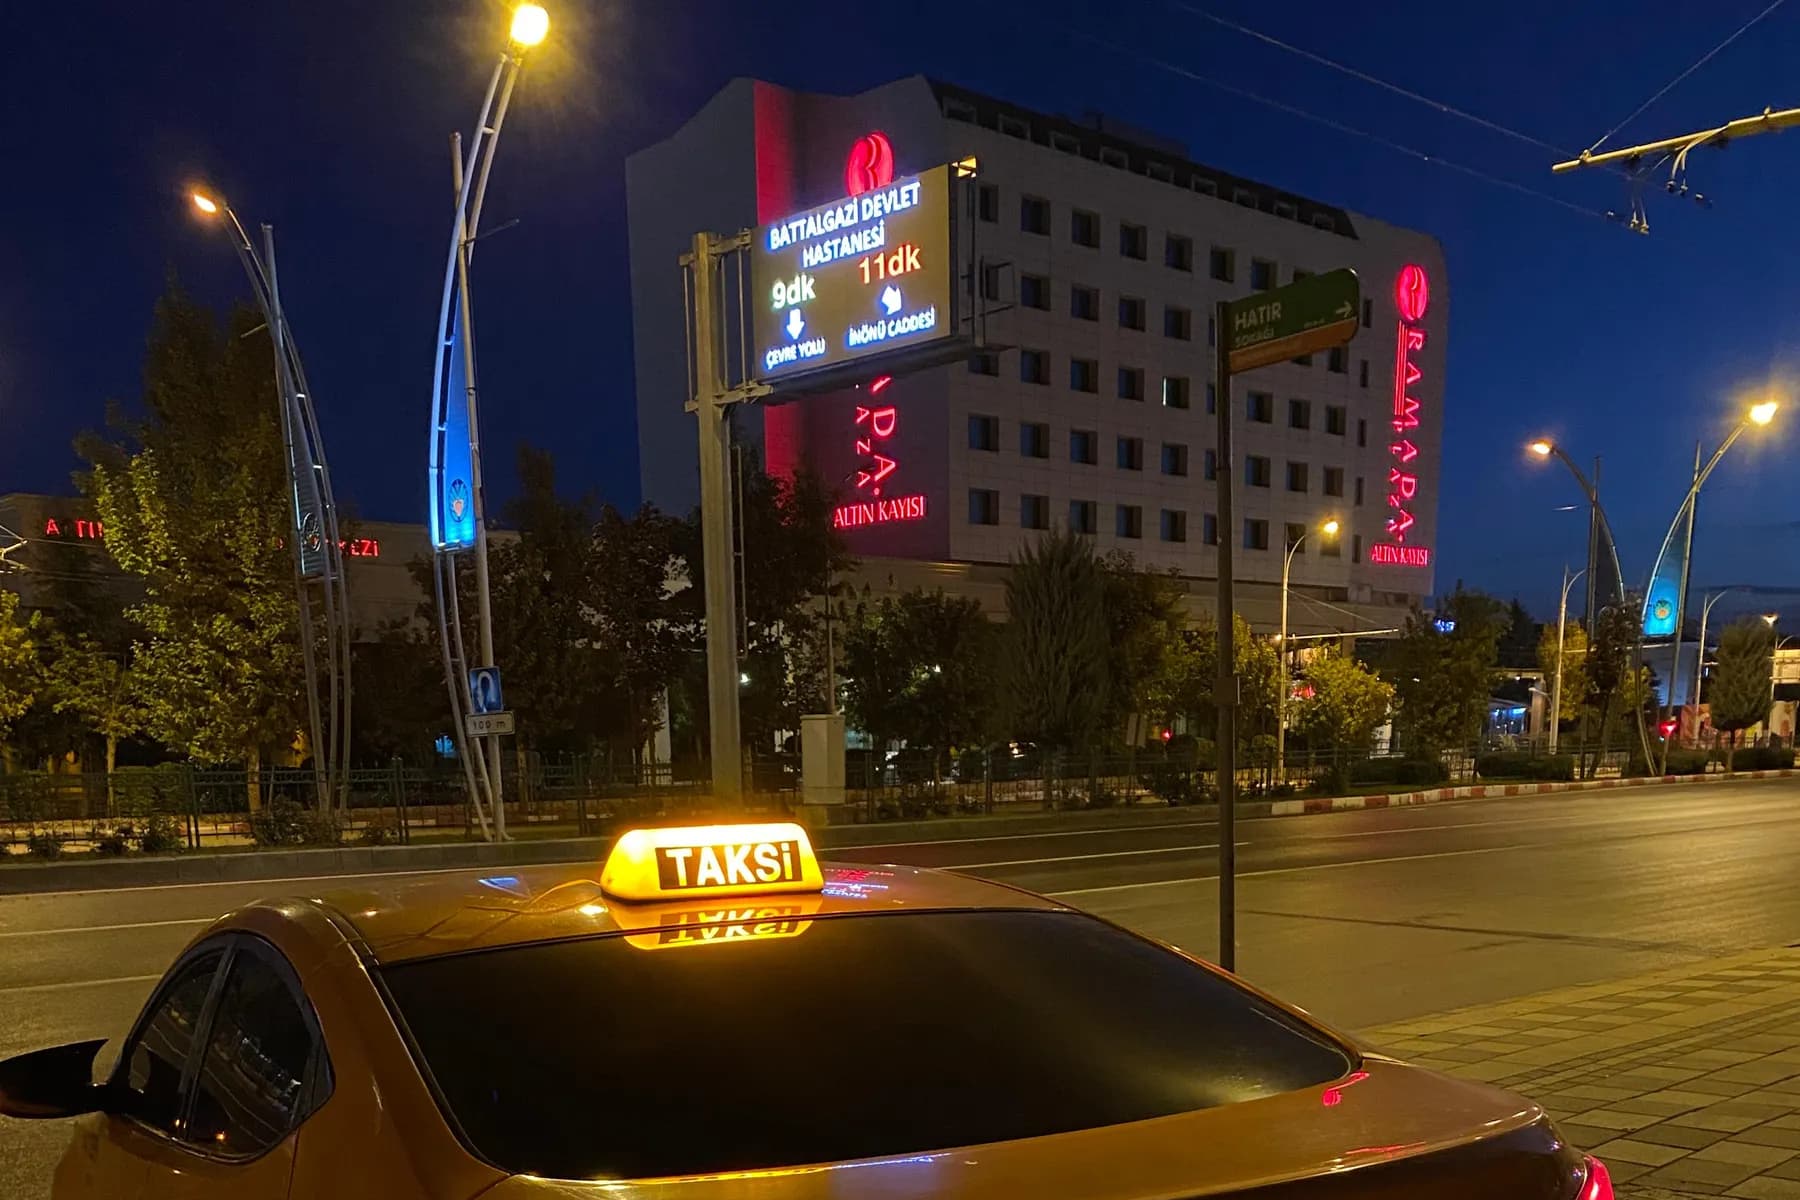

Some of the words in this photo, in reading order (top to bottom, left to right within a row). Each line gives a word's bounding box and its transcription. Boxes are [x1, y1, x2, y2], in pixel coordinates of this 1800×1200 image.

[770, 198, 858, 249] BATTALGAZİ
[862, 182, 921, 219] DEVLET
[803, 219, 886, 268] HASTANESİ
[859, 245, 921, 284] 11dk
[772, 273, 816, 309] 9dk
[1235, 302, 1282, 331] HATIR
[766, 344, 797, 369] ÇEVRE
[834, 504, 874, 528] ALTIN
[879, 495, 924, 521] KAYISI
[1371, 546, 1399, 563] ALTIN
[1400, 547, 1428, 566] KAYISI
[473, 719, 492, 730] 100
